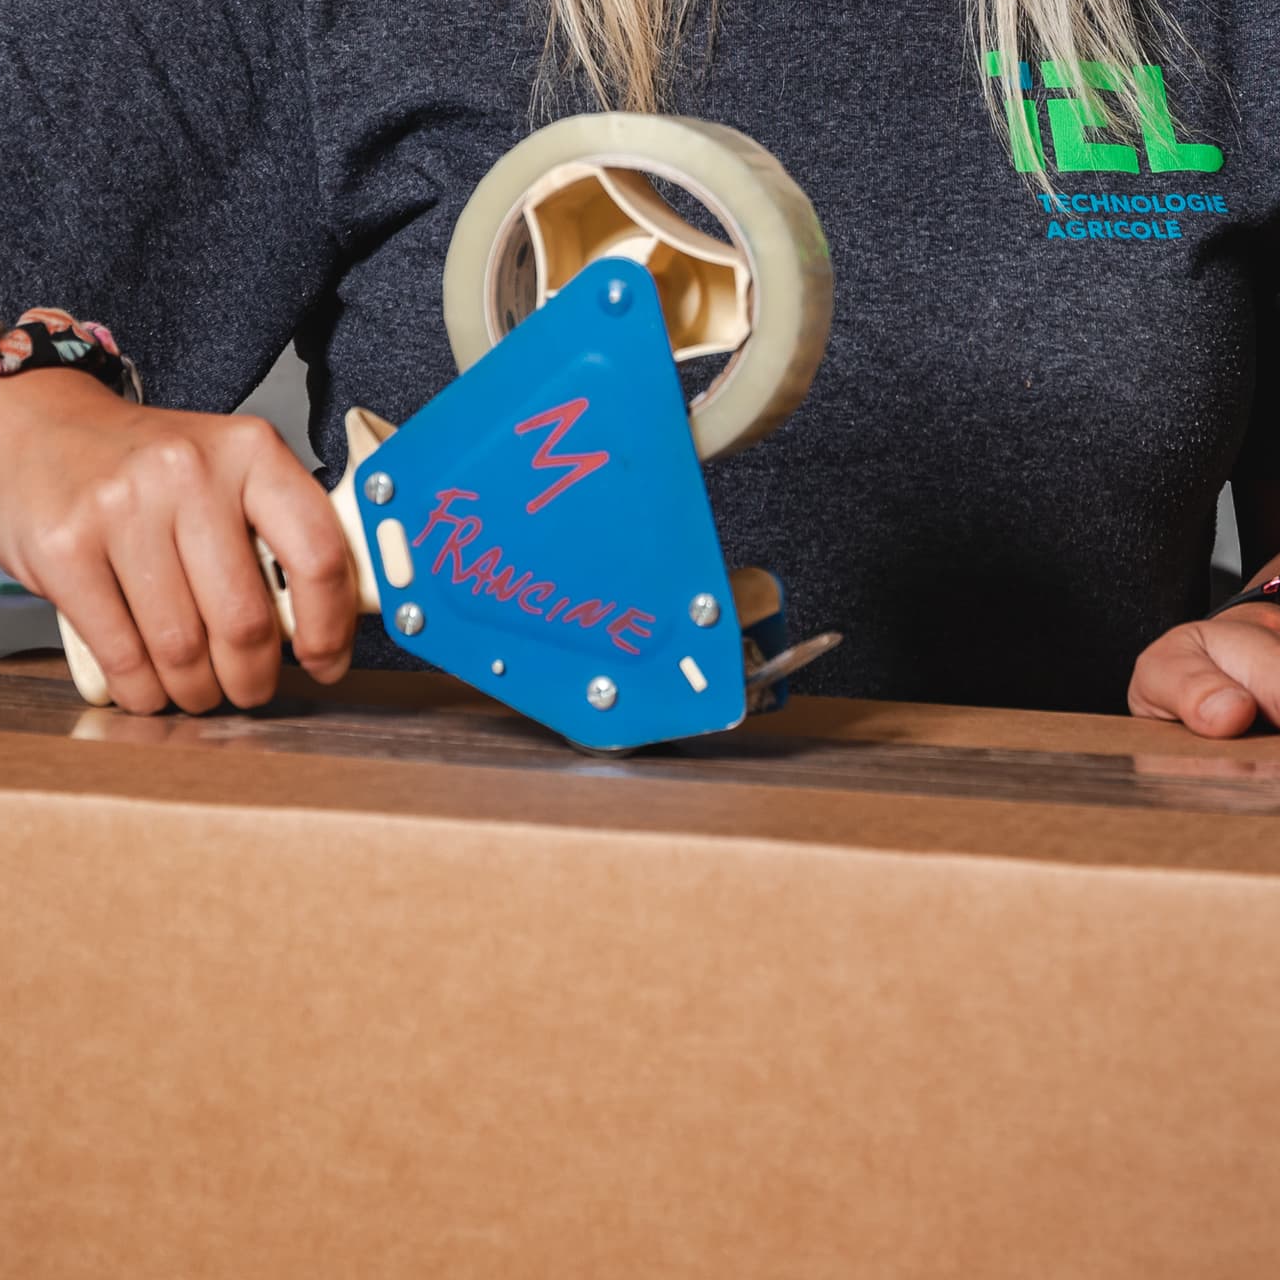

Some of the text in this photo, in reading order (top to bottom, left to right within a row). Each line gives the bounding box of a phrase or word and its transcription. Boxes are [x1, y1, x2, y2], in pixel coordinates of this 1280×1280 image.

[1037, 193, 1229, 214] TECHNOLOGIE
[1047, 220, 1183, 240] AGRICOLE
[412, 488, 657, 656] FRANCINE
